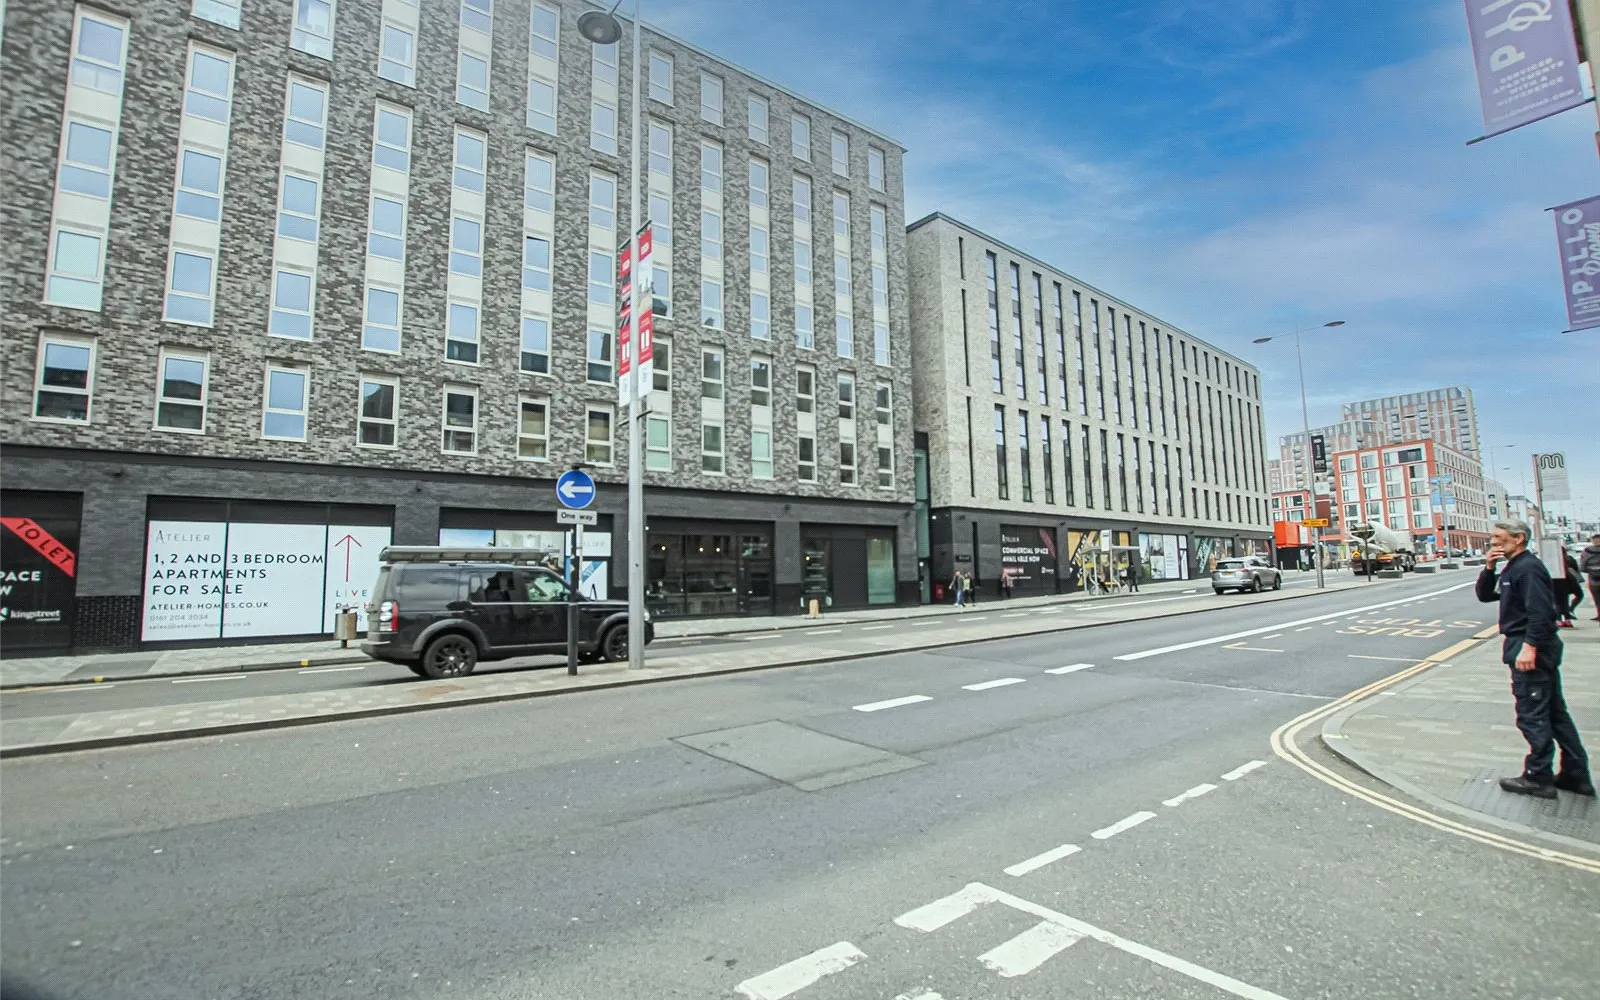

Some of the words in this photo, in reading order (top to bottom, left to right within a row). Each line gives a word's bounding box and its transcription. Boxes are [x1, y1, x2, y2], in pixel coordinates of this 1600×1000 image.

[1493, 60, 1565, 94] APARTMENTS
[1497, 76, 1564, 107] DIFFERENCE
[16, 519, 40, 540] TO
[39, 539, 73, 565] LET
[154, 553, 165, 565] 1,
[170, 553, 178, 563] 2
[184, 553, 222, 564] AND
[231, 553, 239, 564] 3
[244, 553, 323, 564] BEDROOM
[153, 569, 267, 579] APARTMENTS
[152, 585, 189, 595] FOR
[201, 585, 244, 594] SALE
[336, 590, 368, 598] LIVE
[10, 610, 61, 620] kingstreet
[1355, 617, 1483, 629] STOP
[1335, 625, 1446, 638] BUS
